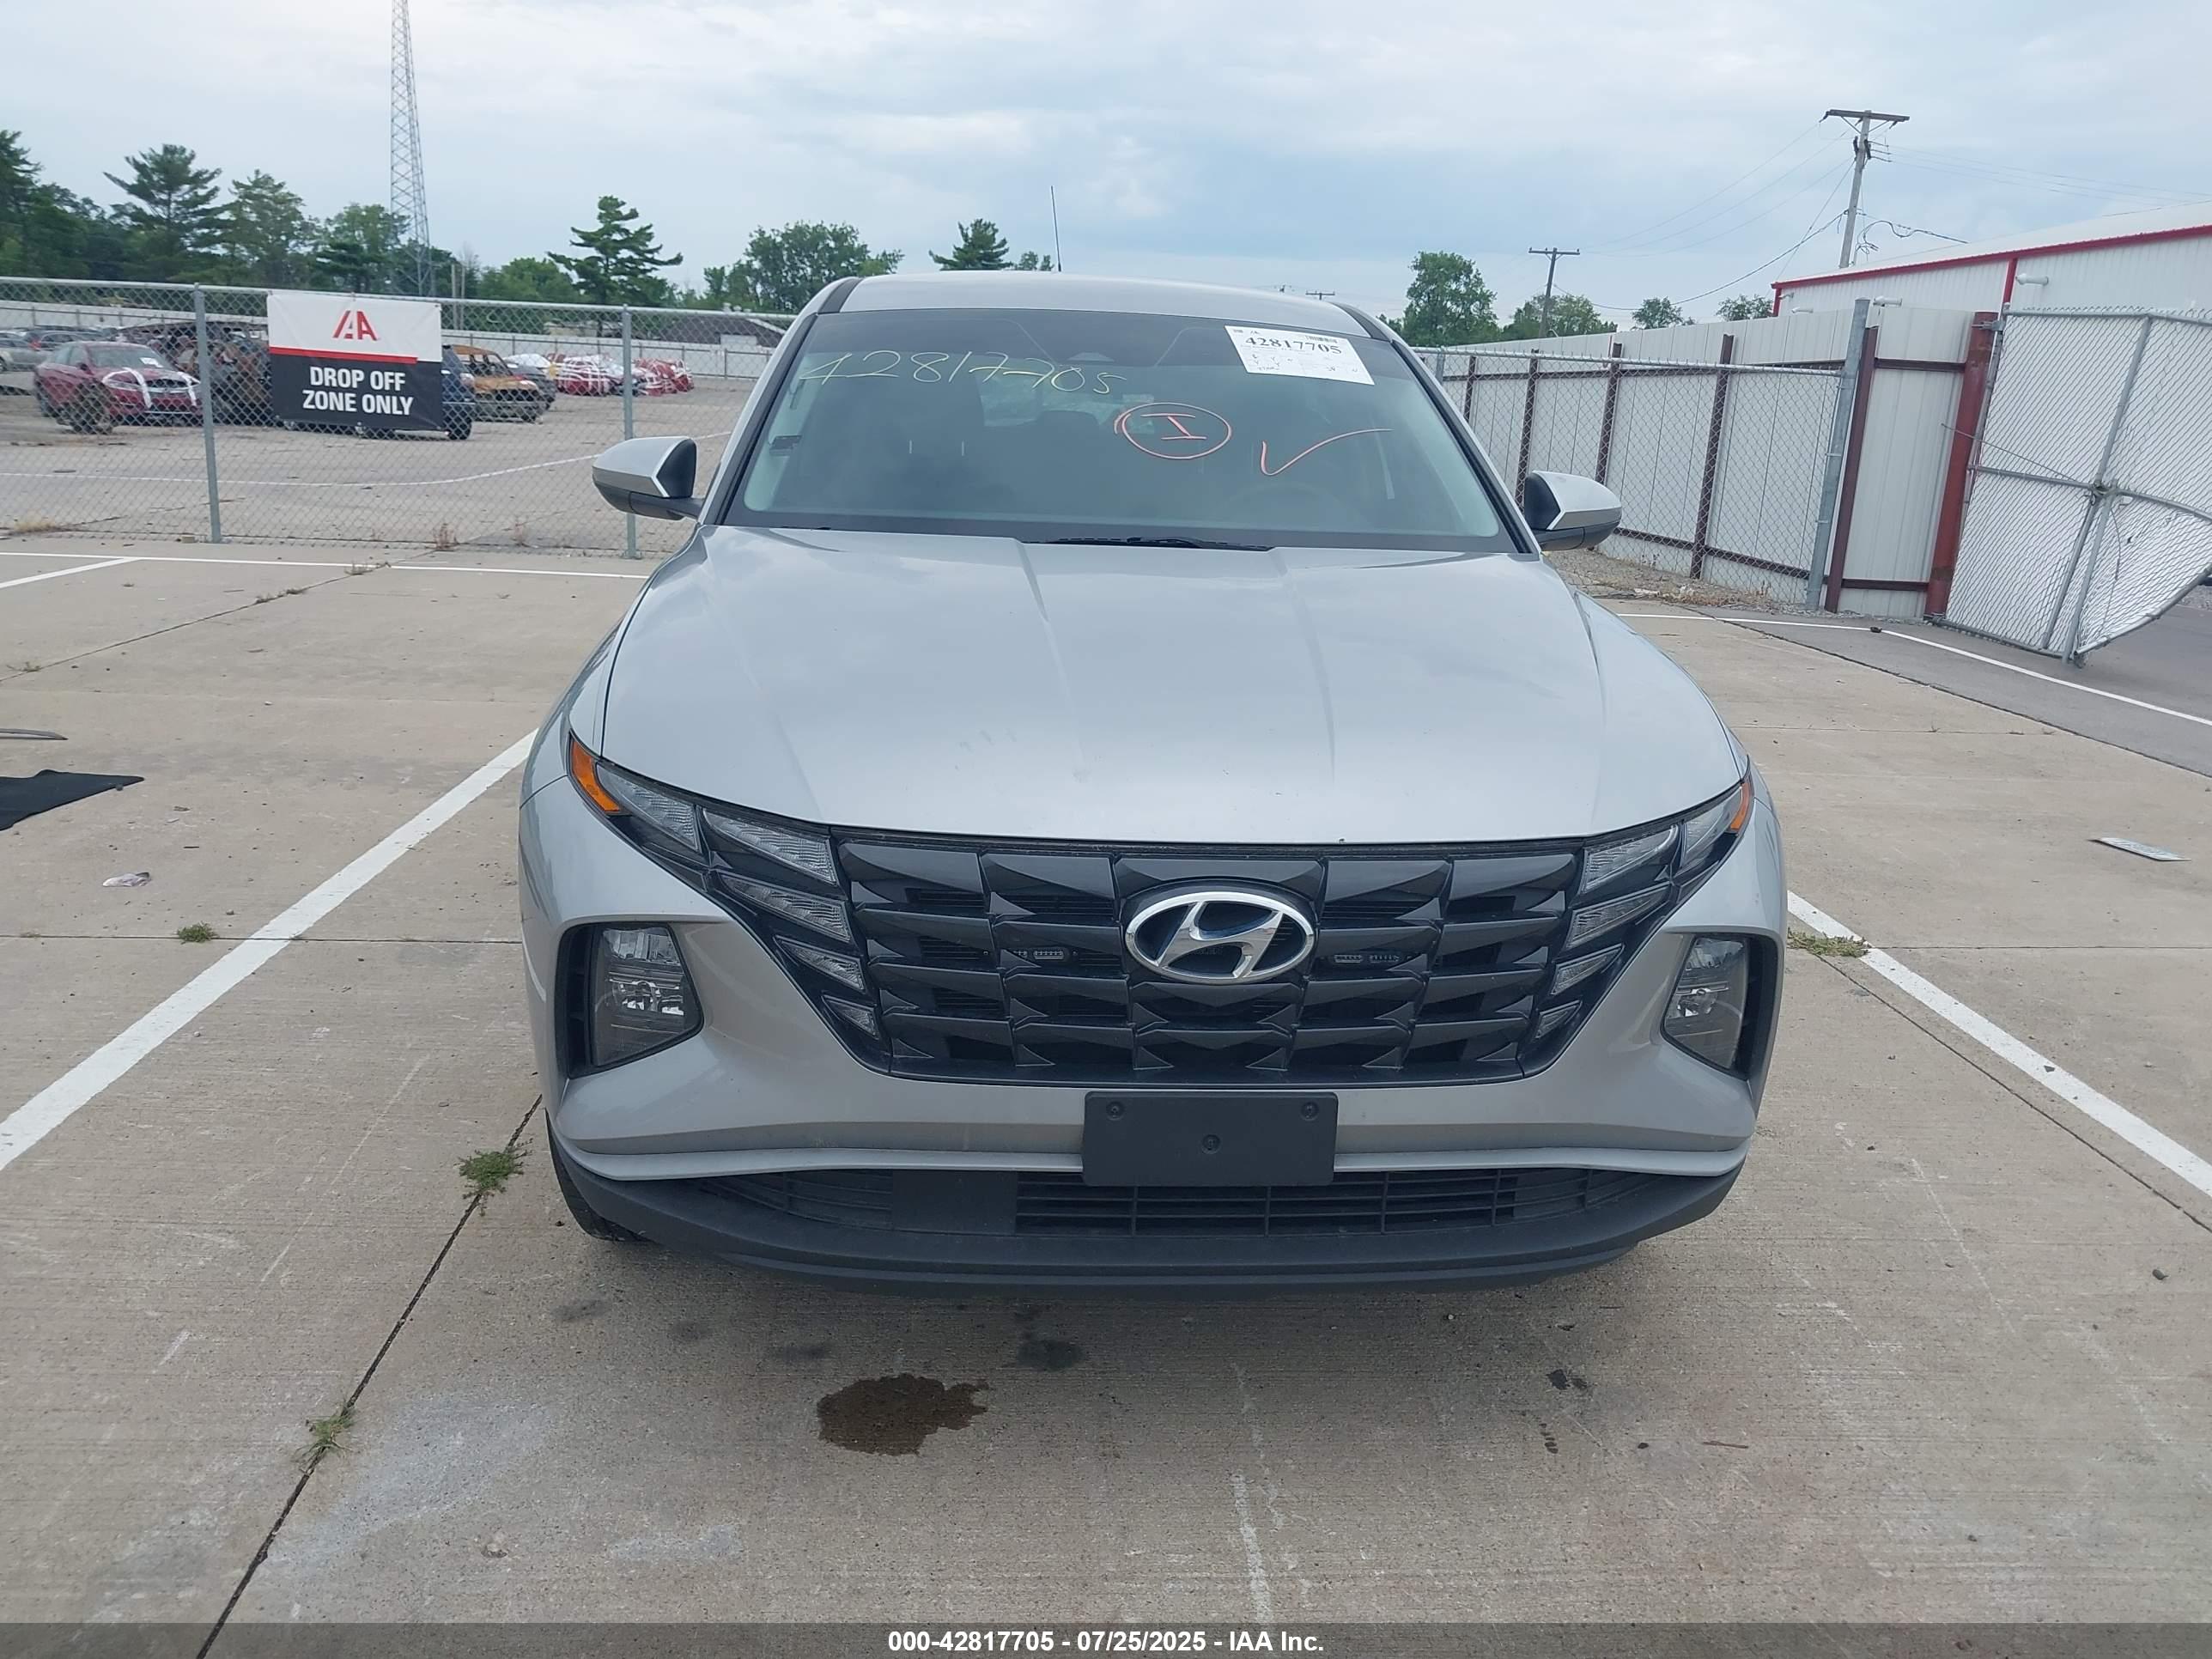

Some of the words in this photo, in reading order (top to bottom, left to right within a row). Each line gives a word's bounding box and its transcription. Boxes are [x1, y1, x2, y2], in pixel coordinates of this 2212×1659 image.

[1245, 336, 1342, 355] 42817705
[309, 366, 365, 390] DROP
[370, 370, 406, 392] OFF
[799, 349, 1127, 394] 42817705
[302, 389, 357, 413] ZONE
[362, 393, 414, 416] ONLY
